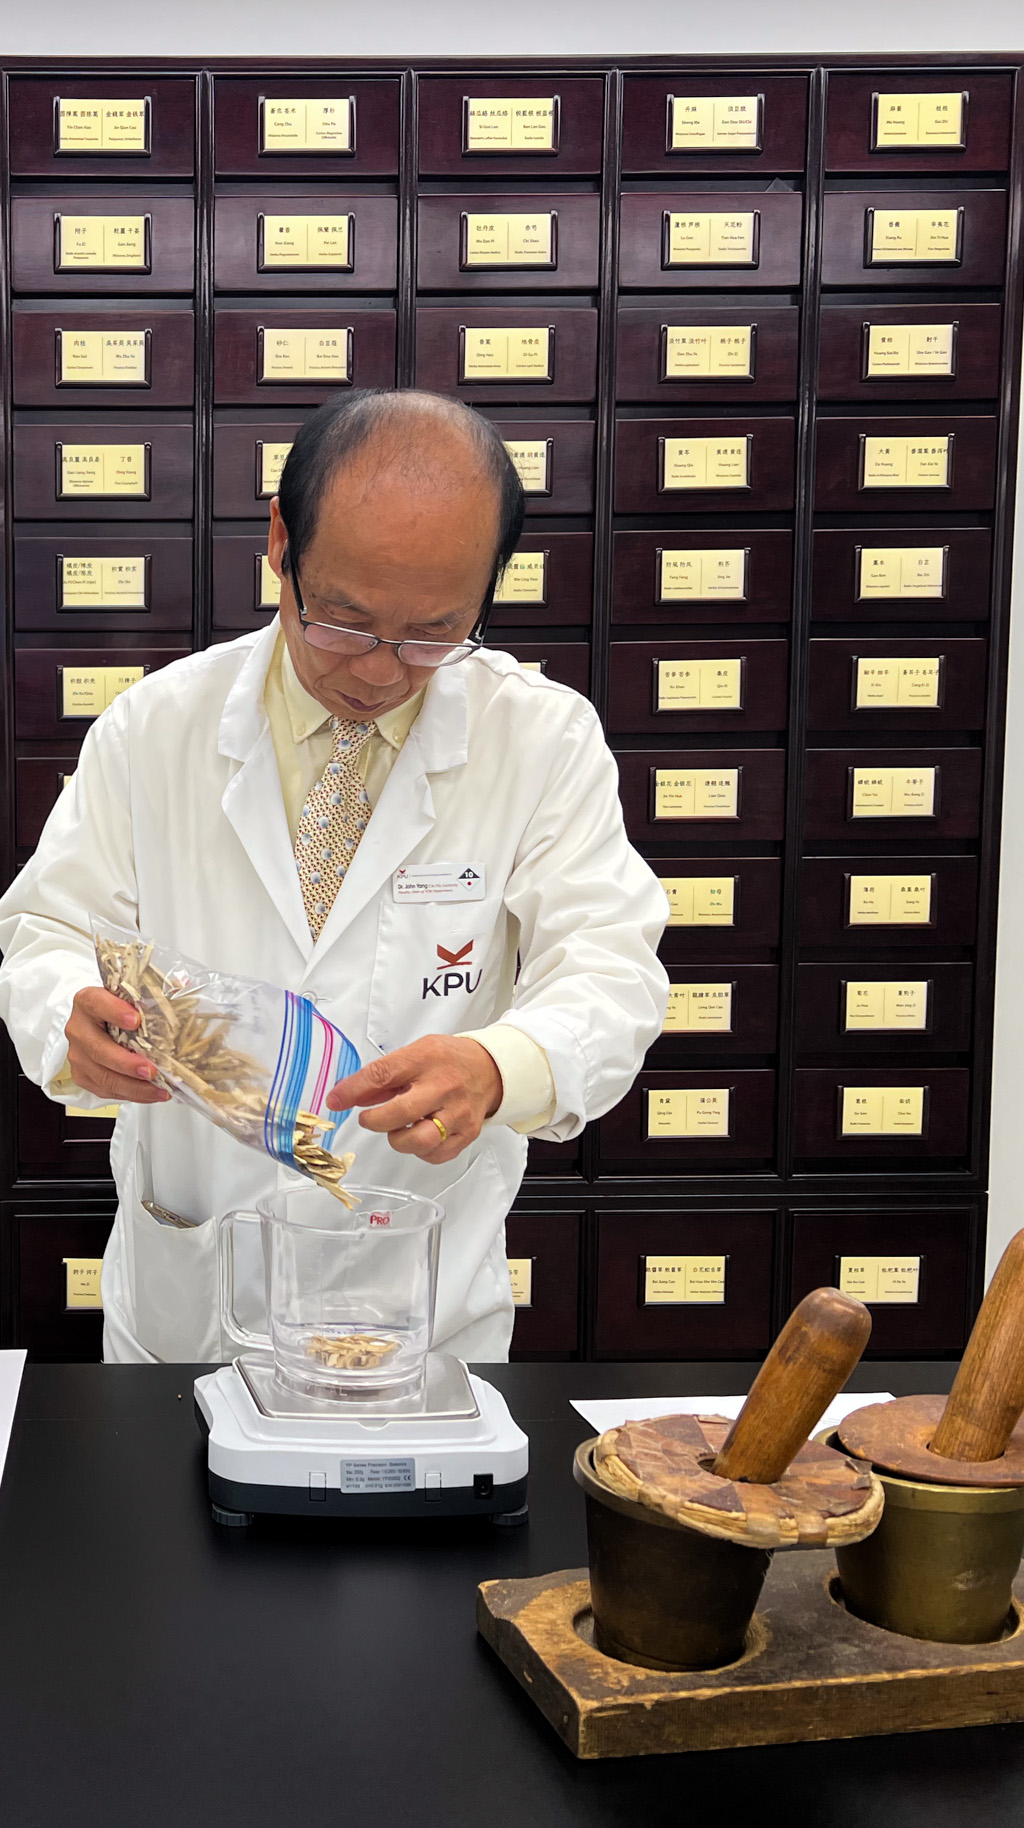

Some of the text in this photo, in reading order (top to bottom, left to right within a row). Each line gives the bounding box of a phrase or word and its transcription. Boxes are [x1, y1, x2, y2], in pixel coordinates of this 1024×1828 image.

[464, 871, 474, 879] 10
[422, 969, 483, 999] KPU
[370, 1215, 390, 1225] PRO
